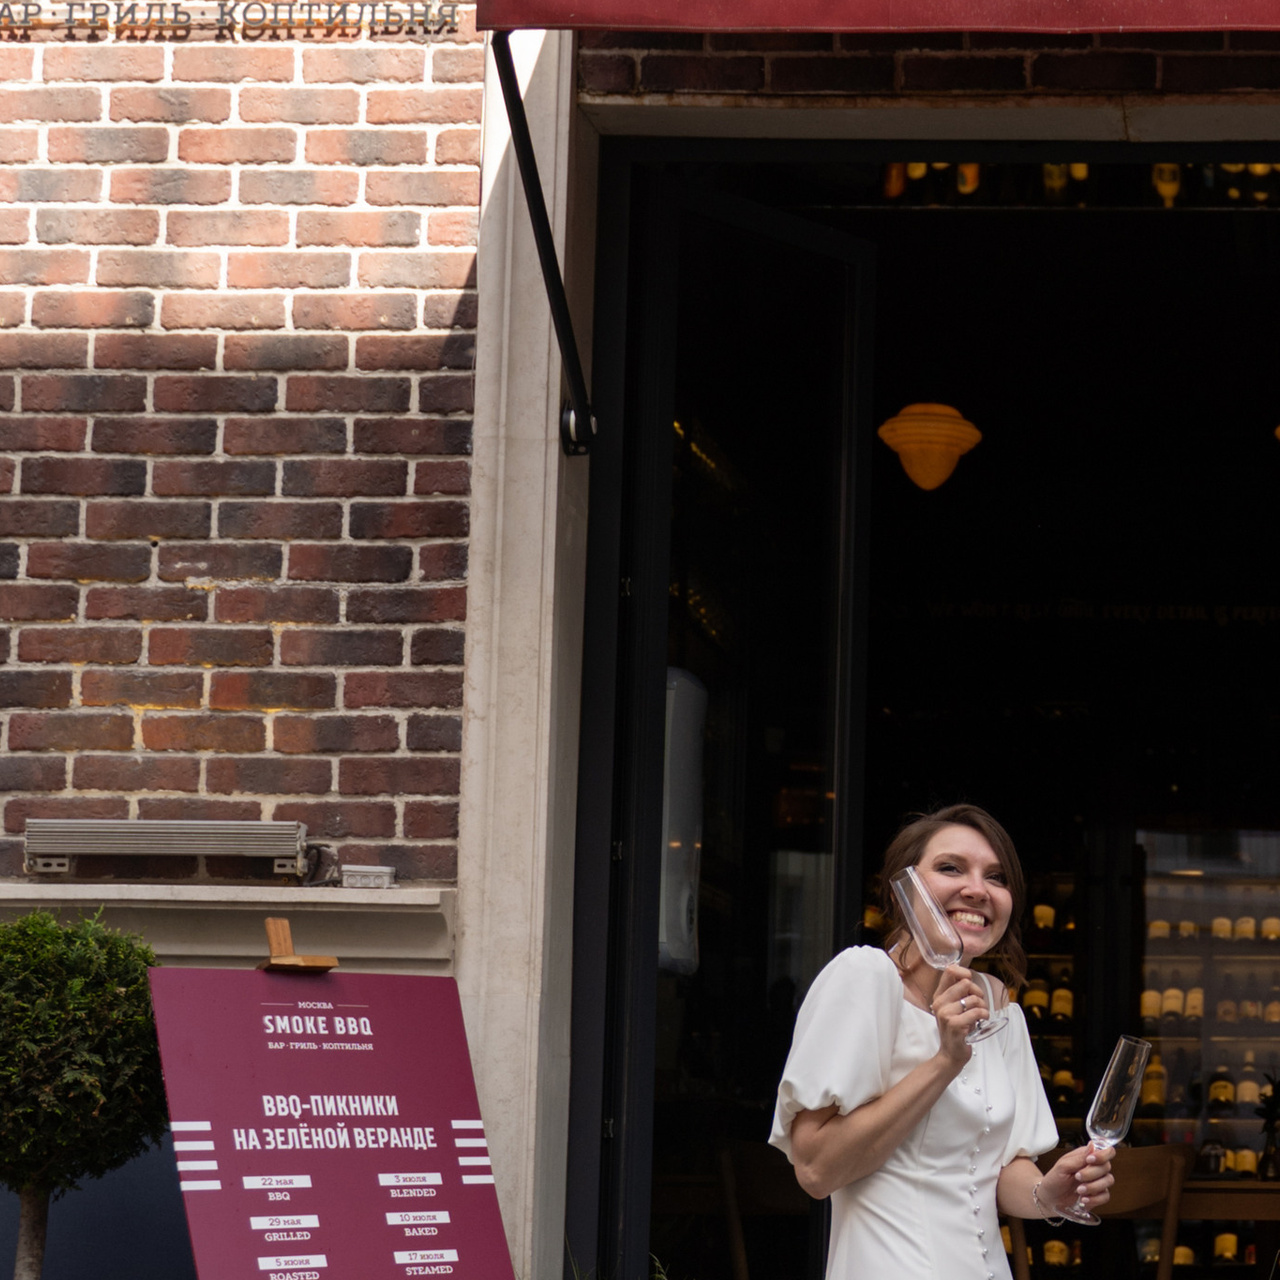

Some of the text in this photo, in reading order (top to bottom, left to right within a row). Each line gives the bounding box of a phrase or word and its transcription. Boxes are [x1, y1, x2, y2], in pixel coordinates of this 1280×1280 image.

[65, 3, 191, 26] ГРИЛЬ
[217, 2, 459, 27] КОПТИЛЬНЯ
[298, 1001, 334, 1009] МОСКВА
[263, 1015, 374, 1035] SMOKE BBQ
[268, 1042, 374, 1051] БАР ГРИЛЬ КОПТИЛЬНЯ
[262, 1094, 399, 1119] BBQ-ПИКНИКИ
[233, 1122, 438, 1150] НА ЗЕЛЁНОЙ ВЕРАНДЕ
[261, 1177, 294, 1186] 22 мая
[394, 1175, 401, 1183] 3
[268, 1192, 291, 1201] BBQ
[390, 1188, 436, 1198] BLENDED
[268, 1218, 302, 1226] 29 мая
[400, 1214, 410, 1222] 10
[264, 1231, 311, 1242] GRILLED
[404, 1227, 438, 1237] BAKED
[408, 1252, 418, 1261] 17
[275, 1258, 310, 1267] 5 июня
[405, 1265, 454, 1276] STEAMED
